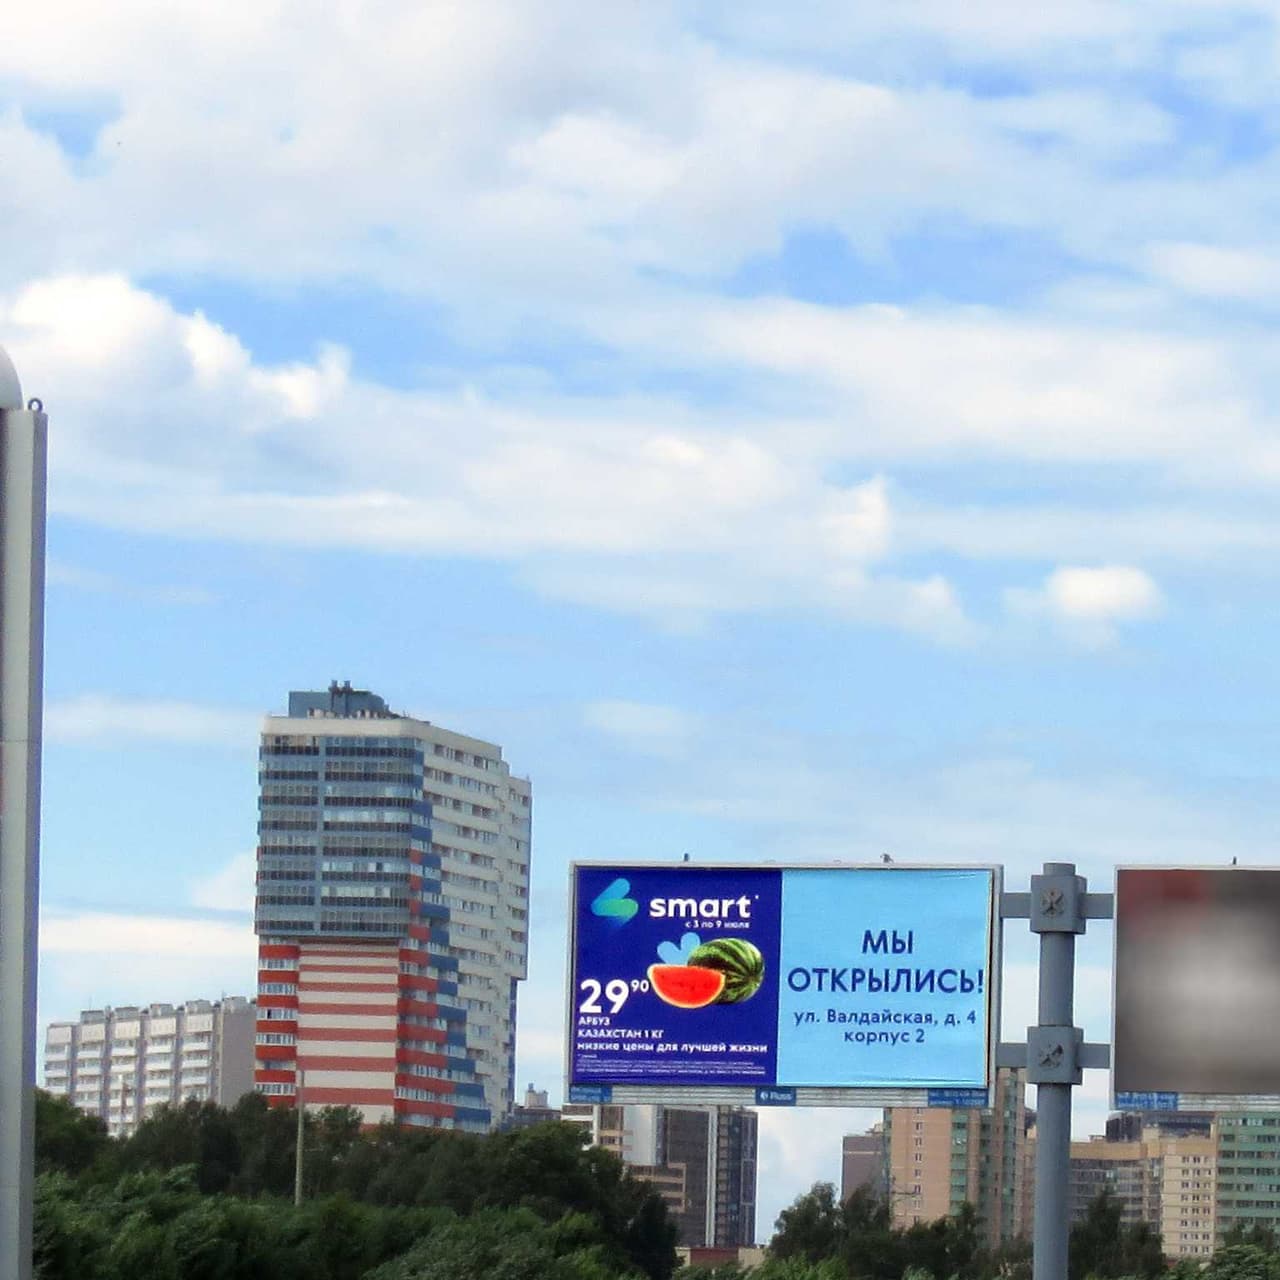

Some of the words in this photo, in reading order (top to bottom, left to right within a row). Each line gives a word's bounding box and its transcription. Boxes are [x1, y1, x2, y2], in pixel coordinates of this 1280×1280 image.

[649, 895, 751, 918] smart
[692, 919, 699, 928] 3
[716, 919, 722, 928] 9
[862, 929, 913, 954] МЫ
[787, 967, 984, 993] ОТКРЫЛИСЬ!
[579, 979, 629, 1014] 29
[578, 1016, 611, 1026] АРБУЗ
[794, 1011, 820, 1025] ул.
[827, 1009, 938, 1025] Валдайская,
[944, 1013, 961, 1026] д.
[966, 1011, 977, 1024] 4
[577, 1029, 642, 1038] КАЗАХСТАН
[644, 1030, 649, 1038] 1
[651, 1030, 664, 1038] КГ
[844, 1030, 910, 1045] корпус
[915, 1029, 925, 1043] 2
[623, 1043, 654, 1052] цены
[656, 1043, 679, 1053] для
[681, 1042, 727, 1053] лучшей
[729, 1044, 768, 1053] жизни
